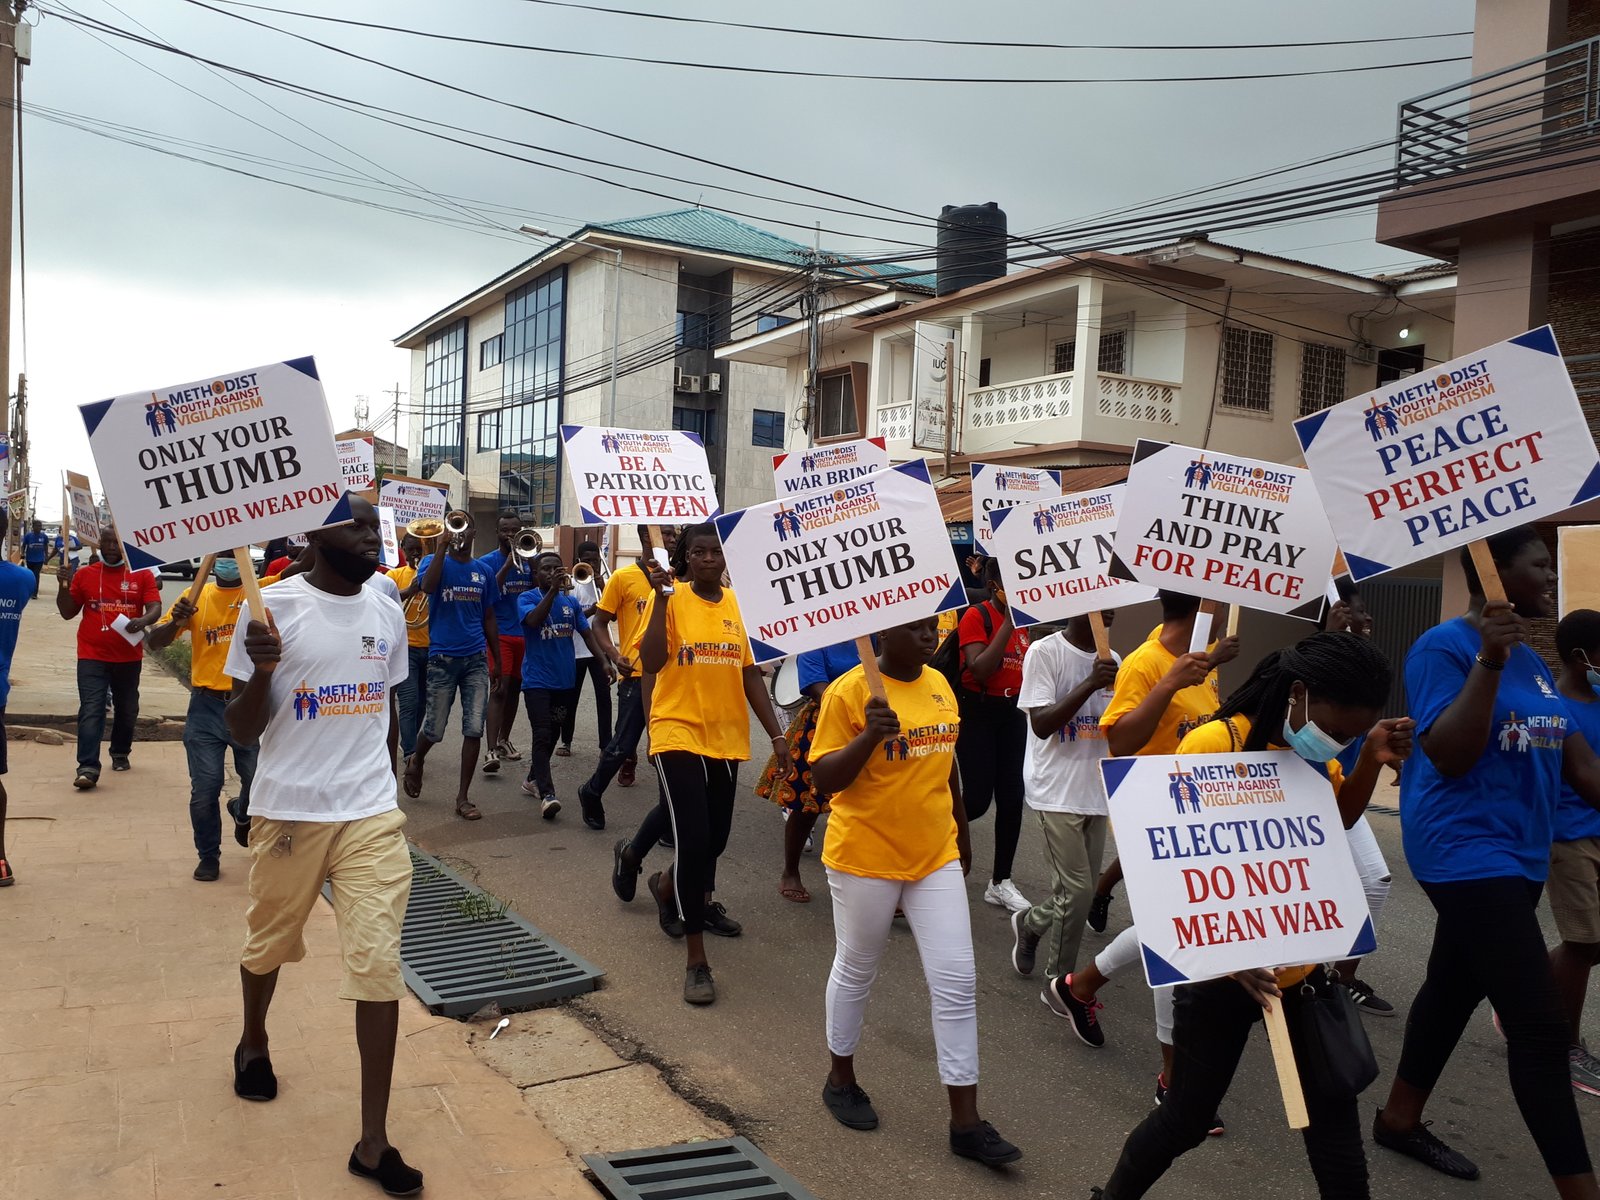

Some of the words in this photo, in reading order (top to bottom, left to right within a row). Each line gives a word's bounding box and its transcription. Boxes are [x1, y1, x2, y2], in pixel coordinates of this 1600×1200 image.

[169, 373, 257, 406] METHODIST
[1389, 360, 1488, 407] METHODIST
[1394, 397, 1436, 417] YOUTH
[1439, 373, 1491, 401] AGAINST
[174, 399, 210, 416] YOUTH
[214, 387, 260, 406] AGAINST
[176, 397, 263, 426] VIGILANTISM
[1397, 383, 1496, 427] VIGILANTISM
[138, 435, 206, 471] ONLY
[212, 416, 292, 452] YOUR
[617, 432, 669, 442] METHODIST
[1376, 404, 1508, 476] PEACE
[619, 446, 672, 454] VIGILANTISM
[813, 445, 857, 458] METHODIST
[814, 455, 833, 463] YOUTH
[834, 452, 857, 460] AGAINST
[342, 463, 369, 475] EACE
[618, 455, 647, 471] BE
[652, 457, 666, 472] A
[815, 457, 858, 469] VIGILANTISM
[1212, 461, 1296, 486] METHODIST
[145, 445, 302, 510] THUMB
[584, 472, 705, 491] PATRIOTIC
[784, 474, 823, 493] WAR
[1004, 471, 1039, 481] METHODIST
[1211, 472, 1245, 485] YOUTH
[1247, 479, 1292, 494] AGAINST
[1364, 431, 1544, 520] PERFECT
[794, 481, 875, 514] METHODIST
[1006, 484, 1040, 492] VIGILANTISM
[1211, 480, 1290, 503] VIGILANTISM
[133, 522, 176, 547] NOT
[181, 507, 242, 535] YOUR
[243, 482, 340, 520] WEAPON
[401, 510, 417, 518] OUR
[413, 506, 442, 515] ELECTION
[420, 501, 443, 509] ABOUT
[592, 495, 710, 517] CITIZEN
[799, 506, 832, 521] YOUTH
[835, 493, 877, 512] AGAINST
[1050, 494, 1112, 514] METHODIST
[1052, 510, 1079, 520] YOUTH
[1081, 503, 1113, 515] AGAINST
[1181, 493, 1285, 535] THINK
[1403, 477, 1537, 547] PEACE
[801, 502, 881, 531] VIGILANTISM
[1054, 510, 1115, 528] VIGILANTISM
[766, 538, 828, 572] ONLY
[833, 517, 907, 553] YOUR
[979, 529, 992, 540] TO
[1143, 518, 1213, 549] AND
[1220, 531, 1307, 569] PRAY
[1014, 538, 1082, 580] SAY
[1092, 531, 1117, 564] N
[771, 542, 915, 606] THUMB
[1132, 544, 1195, 578] FOR
[1202, 558, 1304, 600] PEACE
[1016, 587, 1042, 605] TO
[1045, 574, 1121, 599] VIGILAN
[758, 616, 799, 641] NOT
[803, 600, 860, 628] YOUR
[861, 573, 951, 611] WEAPON
[694, 649, 719, 657] YOUTH
[319, 694, 355, 704] YOUTH
[909, 737, 941, 747] YOUTH
[1192, 762, 1278, 782] METHODIST
[1198, 781, 1235, 793] YOUTH
[1237, 778, 1281, 791] AGAINST
[1199, 789, 1286, 808] VIGILANTISM
[1144, 815, 1326, 860] ELECTIONS
[1181, 865, 1236, 904] DO
[1241, 857, 1311, 897] NOT
[1172, 907, 1267, 950] MEAN
[1269, 899, 1344, 937] WAR
